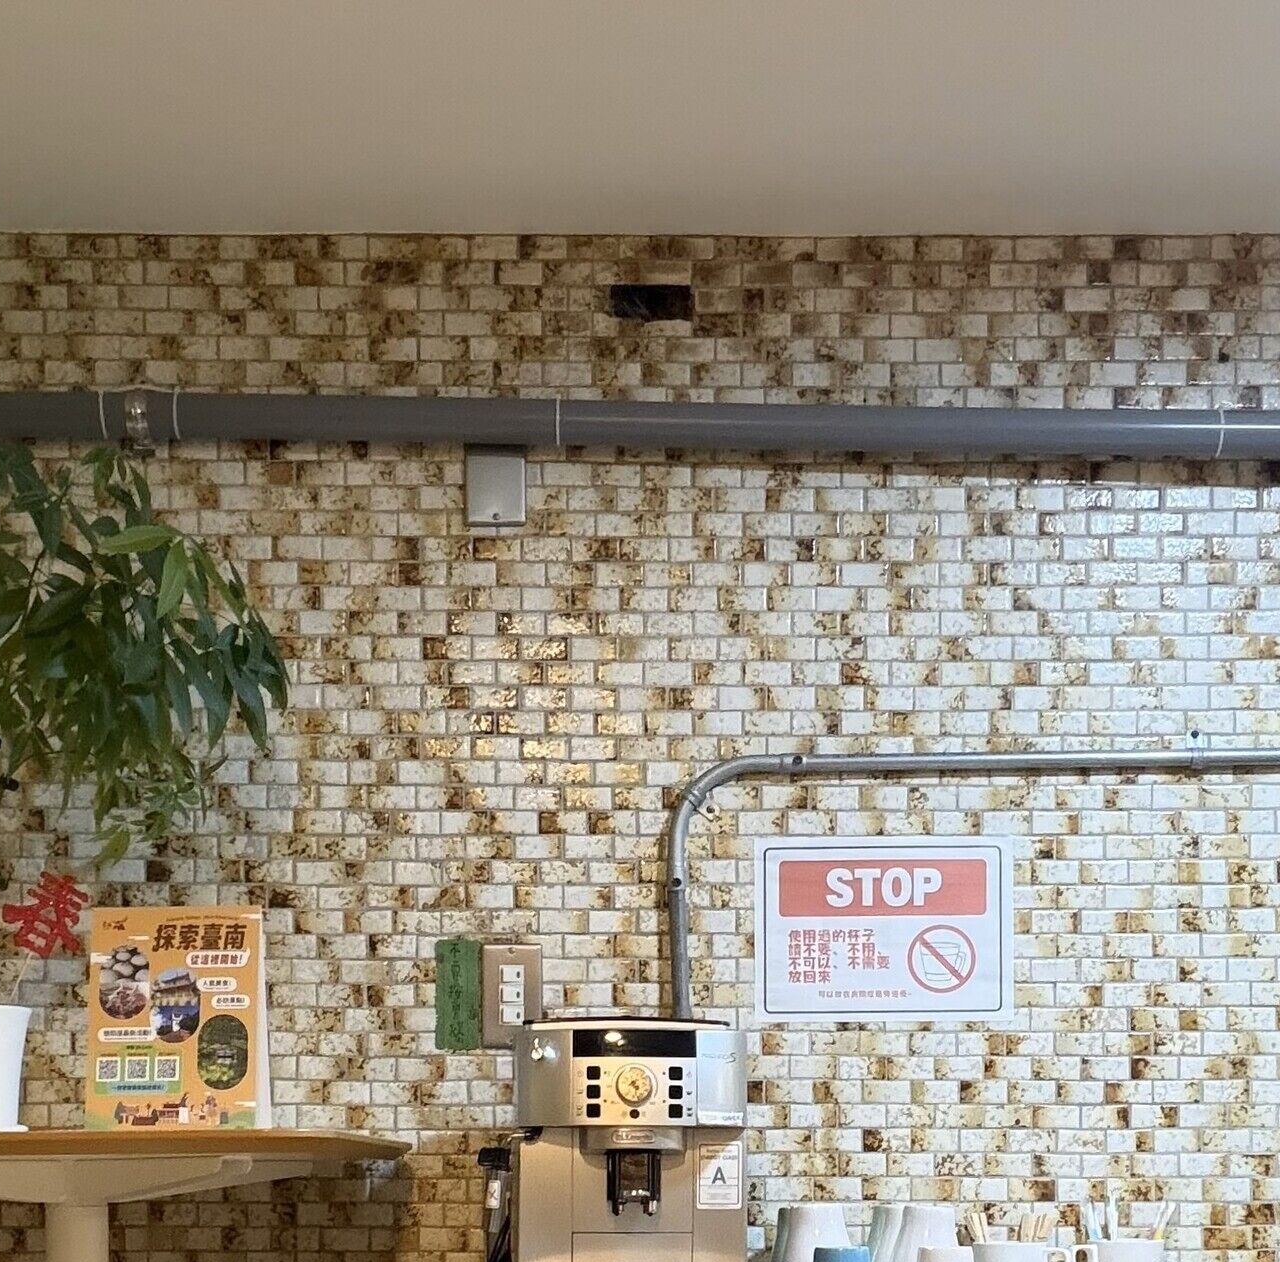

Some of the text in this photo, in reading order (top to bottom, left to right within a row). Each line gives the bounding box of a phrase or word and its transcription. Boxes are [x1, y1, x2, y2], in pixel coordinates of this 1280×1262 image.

[825, 866, 943, 908] STOP
[1, 870, 90, 960] 春
[151, 922, 248, 952] 探索臺南
[788, 928, 875, 943] 使用過的杯子
[788, 970, 831, 984] 放回來
[711, 1166, 727, 1185] A
